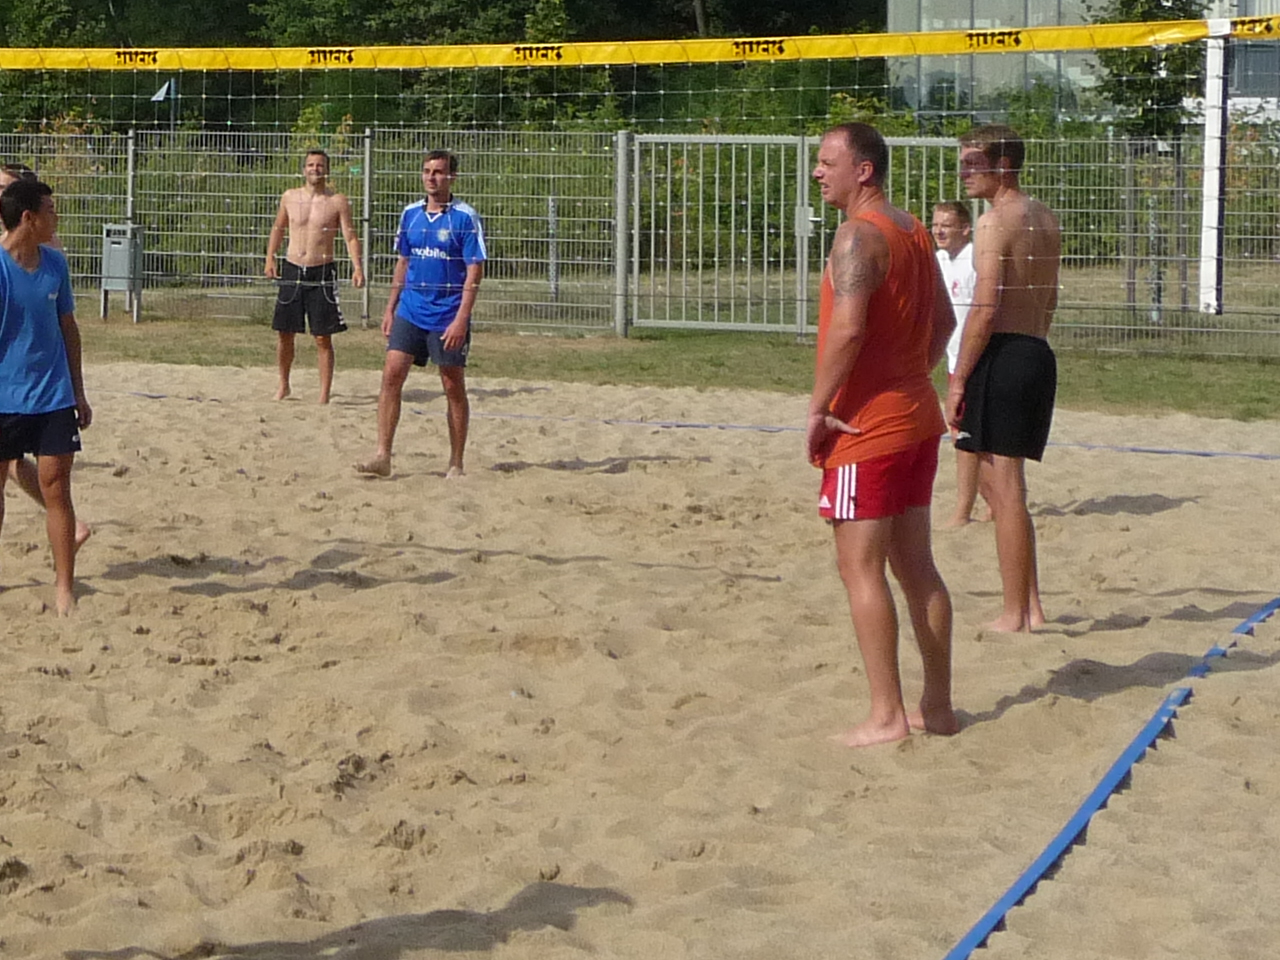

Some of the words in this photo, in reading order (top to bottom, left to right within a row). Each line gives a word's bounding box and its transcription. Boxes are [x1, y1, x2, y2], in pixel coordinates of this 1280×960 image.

[1230, 18, 1273, 35] UCK
[966, 30, 1023, 49] HUCK
[514, 46, 564, 61] HUCK
[731, 39, 786, 57] HUCK
[114, 50, 159, 66] HUCK
[307, 49, 356, 65] HUCK
